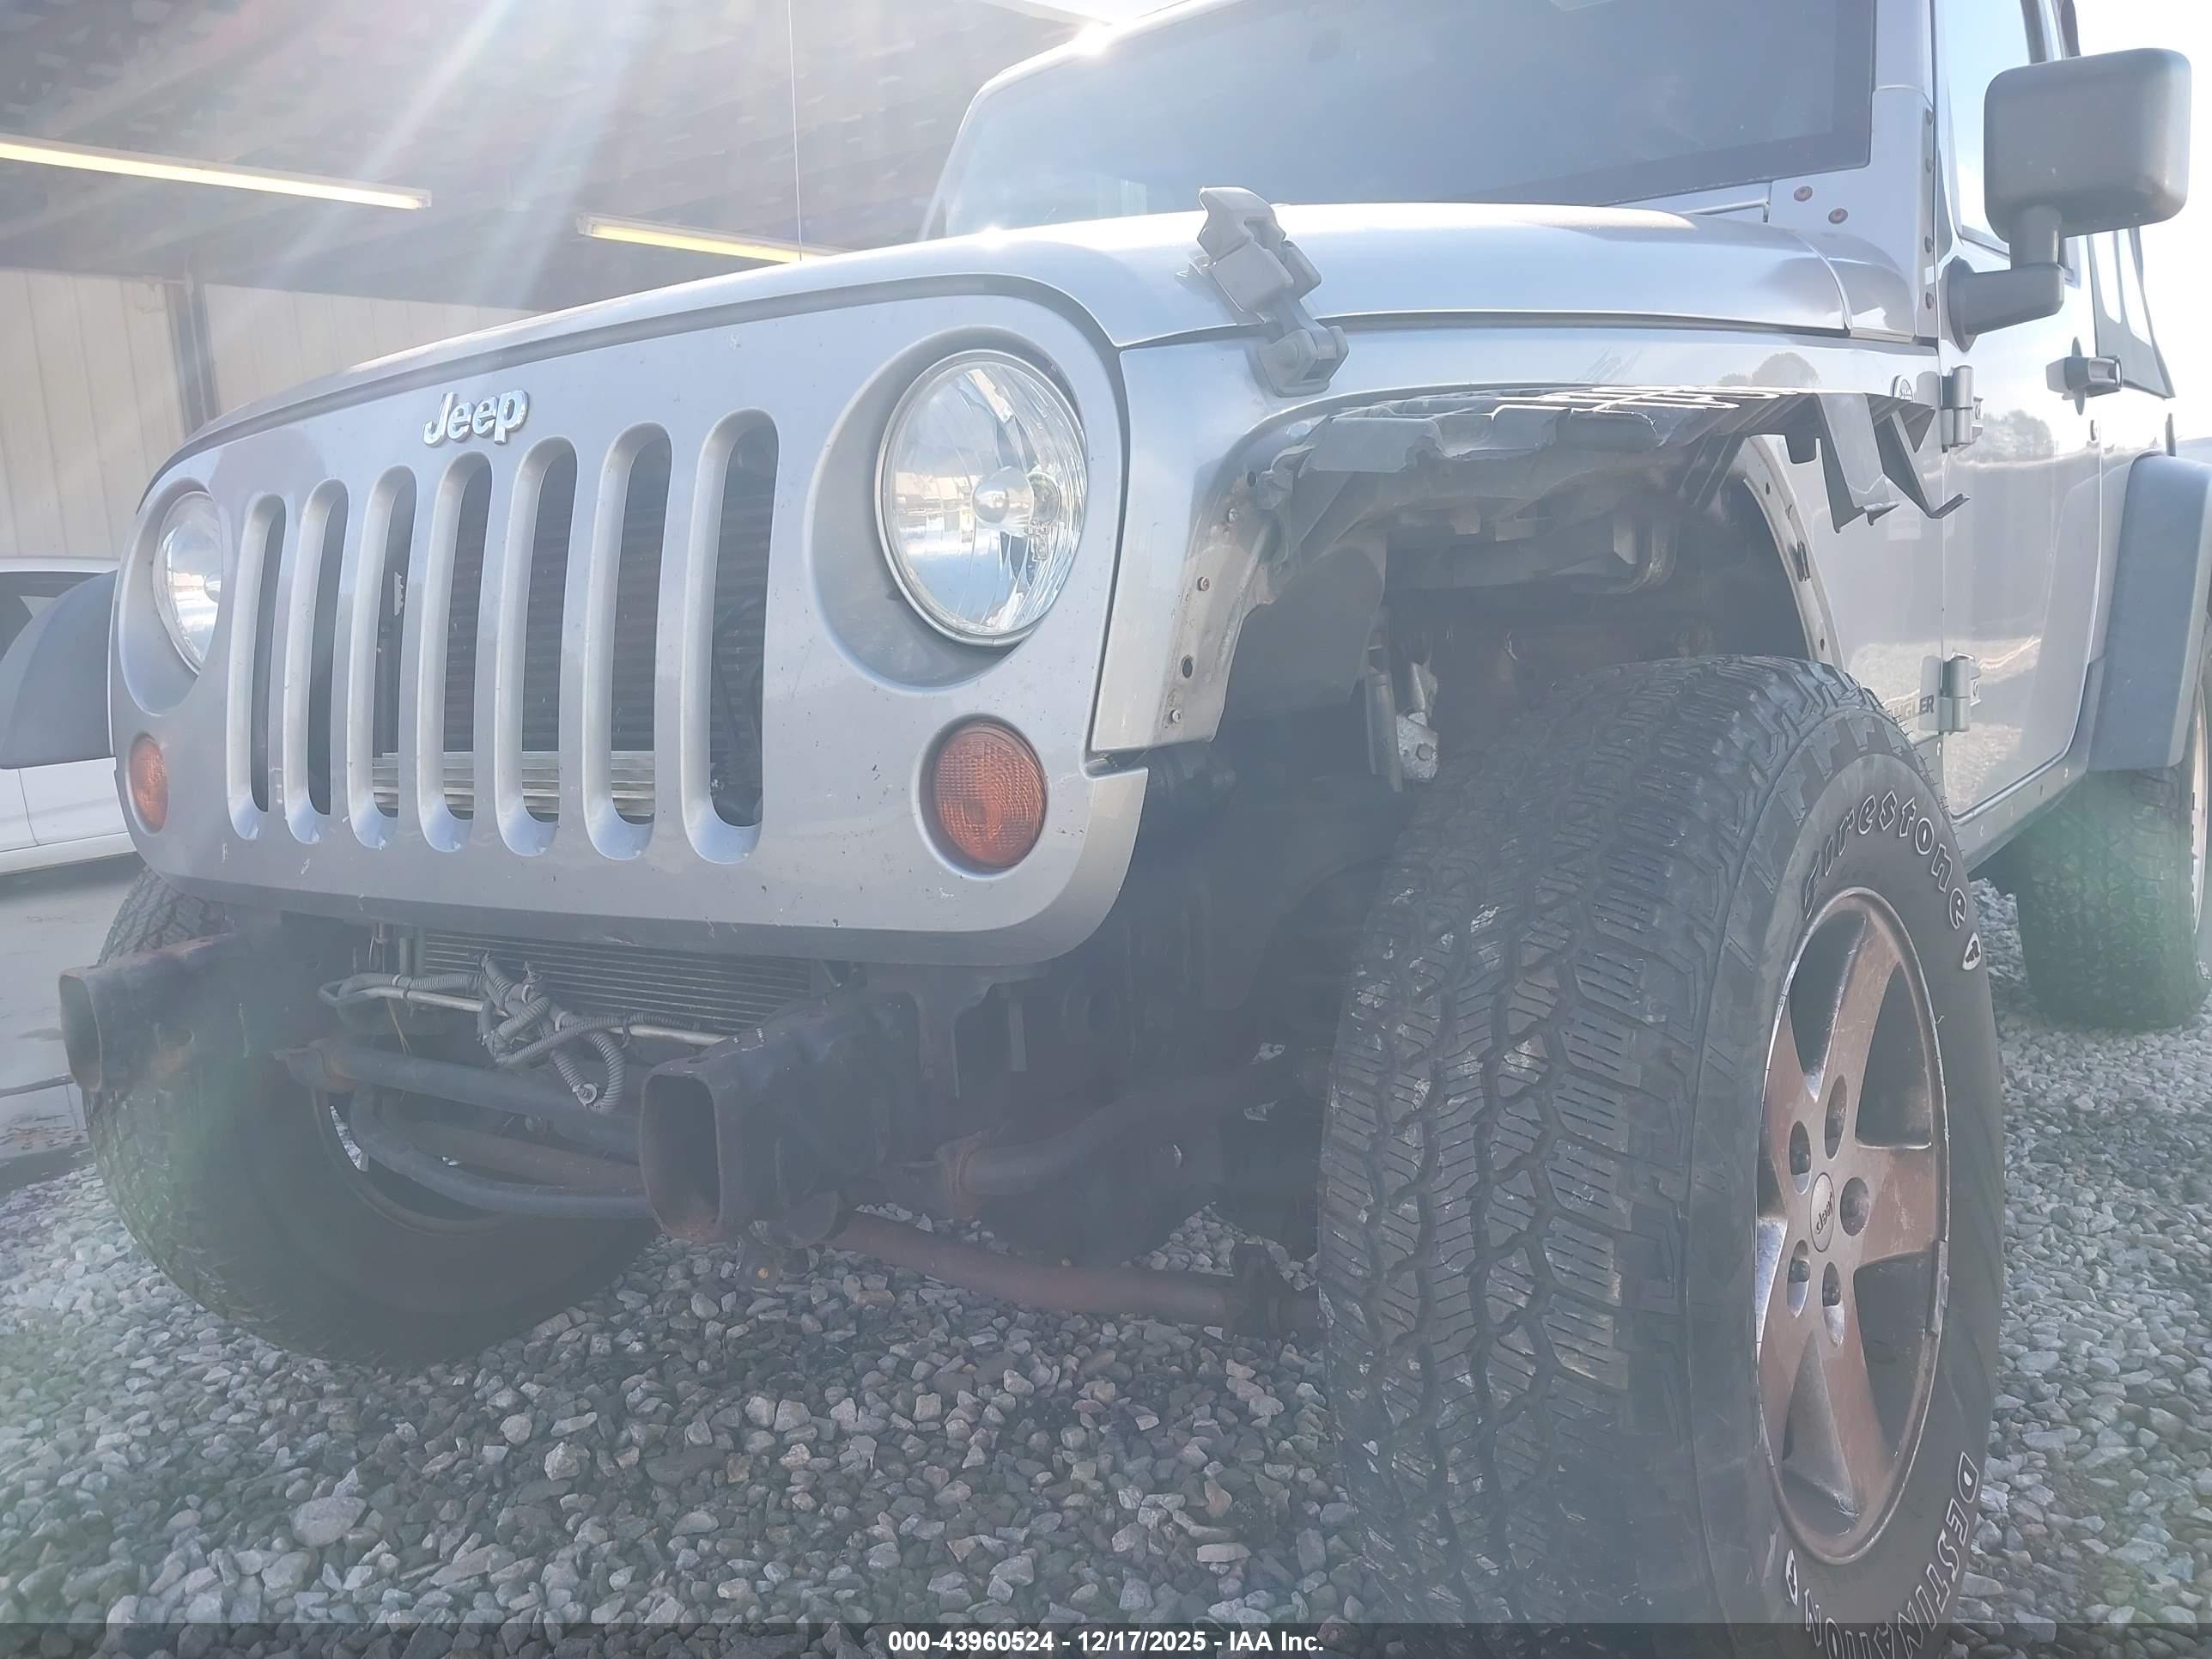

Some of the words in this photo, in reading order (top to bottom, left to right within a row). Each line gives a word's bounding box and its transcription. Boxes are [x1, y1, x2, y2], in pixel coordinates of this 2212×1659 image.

[422, 390, 529, 445] Jeep
[1804, 790, 1967, 930] Firestone
[1816, 1191, 1833, 1234] Jeep
